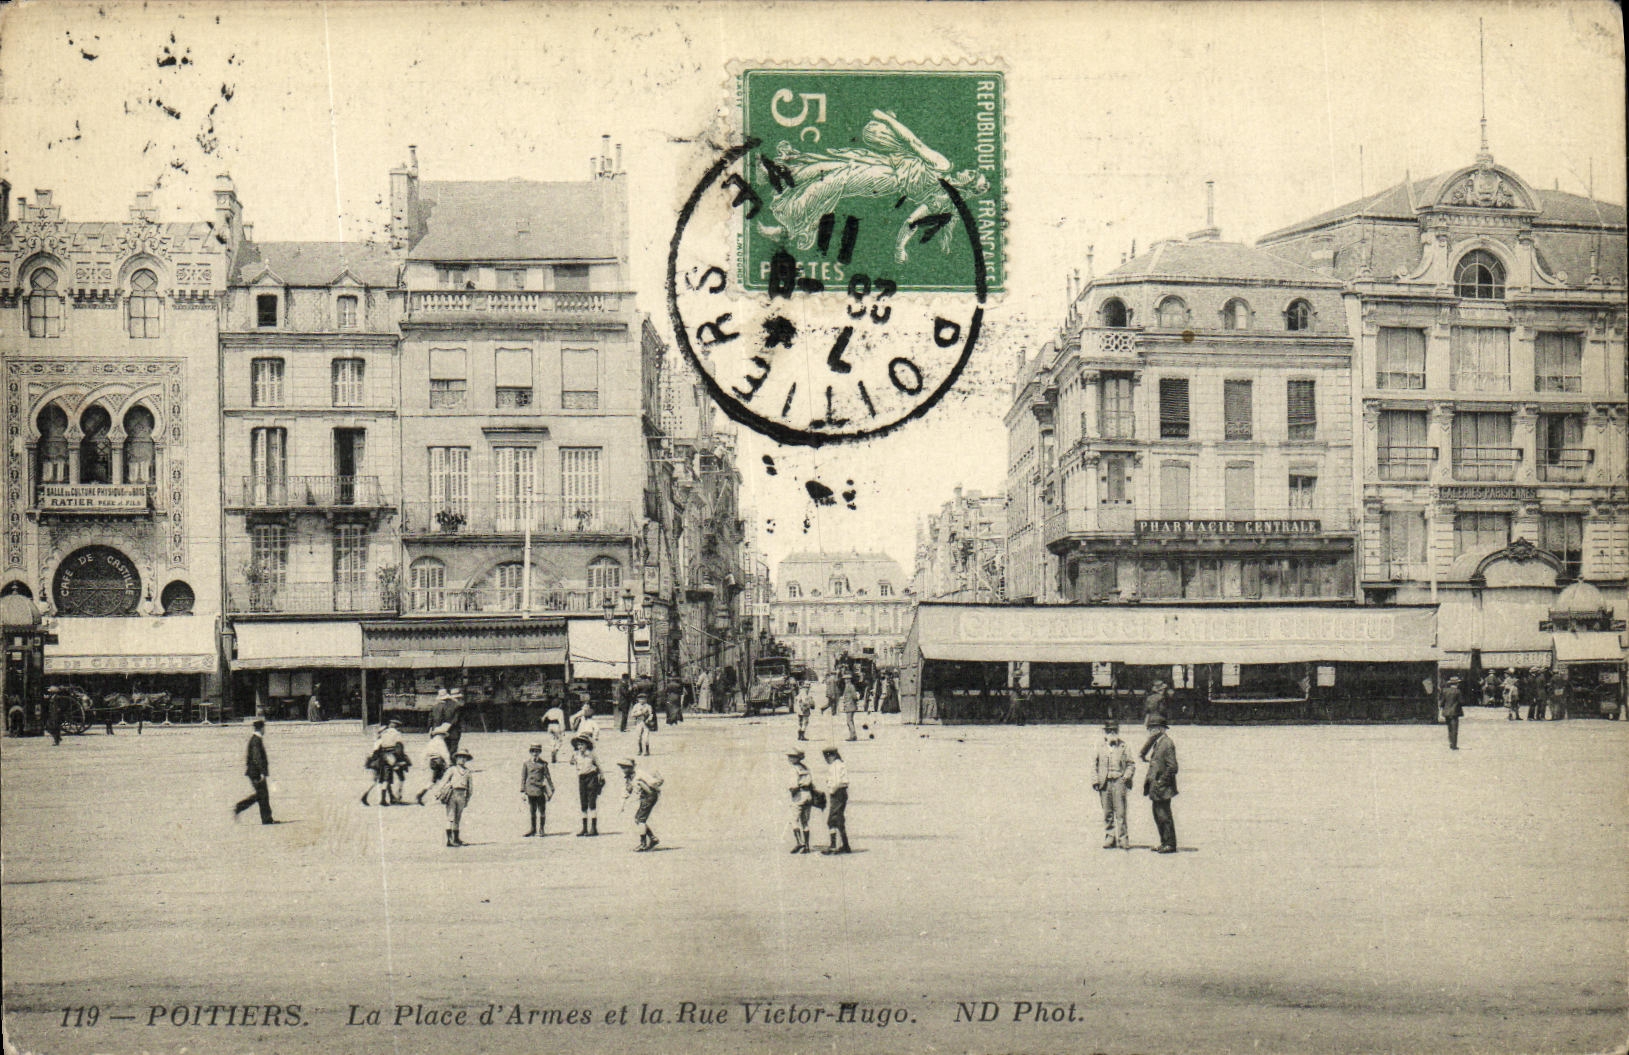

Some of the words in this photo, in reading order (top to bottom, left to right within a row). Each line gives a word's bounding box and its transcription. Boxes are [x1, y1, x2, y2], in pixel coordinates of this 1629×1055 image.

[760, 261, 845, 281] PSTES
[686, 266, 961, 428] POITIERS
[71, 487, 96, 497] CULTURE
[51, 498, 93, 506] RATIER
[1139, 521, 1236, 533] PHARMACIE
[1245, 521, 1316, 533] CENTRALE
[78, 553, 94, 566] DE
[107, 555, 135, 595] CASTILLE
